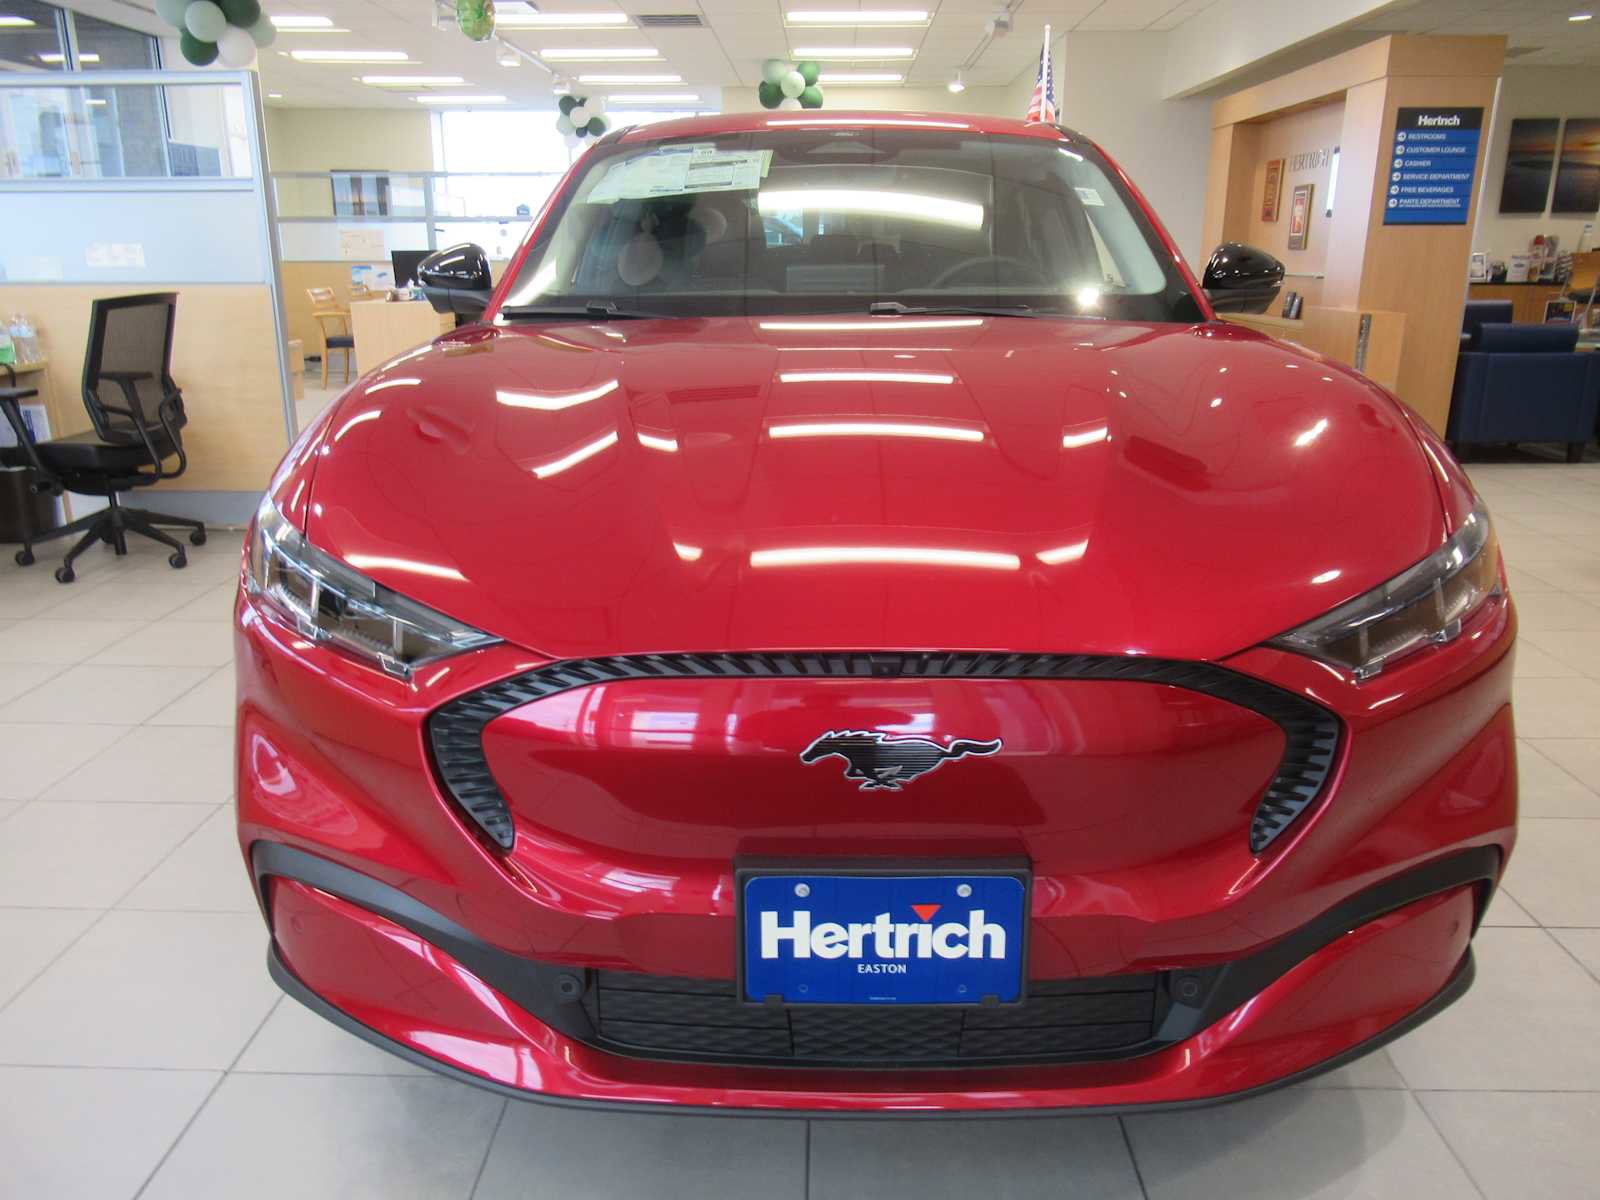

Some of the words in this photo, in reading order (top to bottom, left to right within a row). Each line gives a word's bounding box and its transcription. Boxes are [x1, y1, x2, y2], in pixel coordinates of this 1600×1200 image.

[1418, 115, 1460, 126] Hertrich
[1399, 198, 1419, 206] PARTS
[1419, 198, 1460, 206] DEPARTMENT
[760, 909, 1006, 960] Hertrich
[857, 963, 907, 974] EASTON
